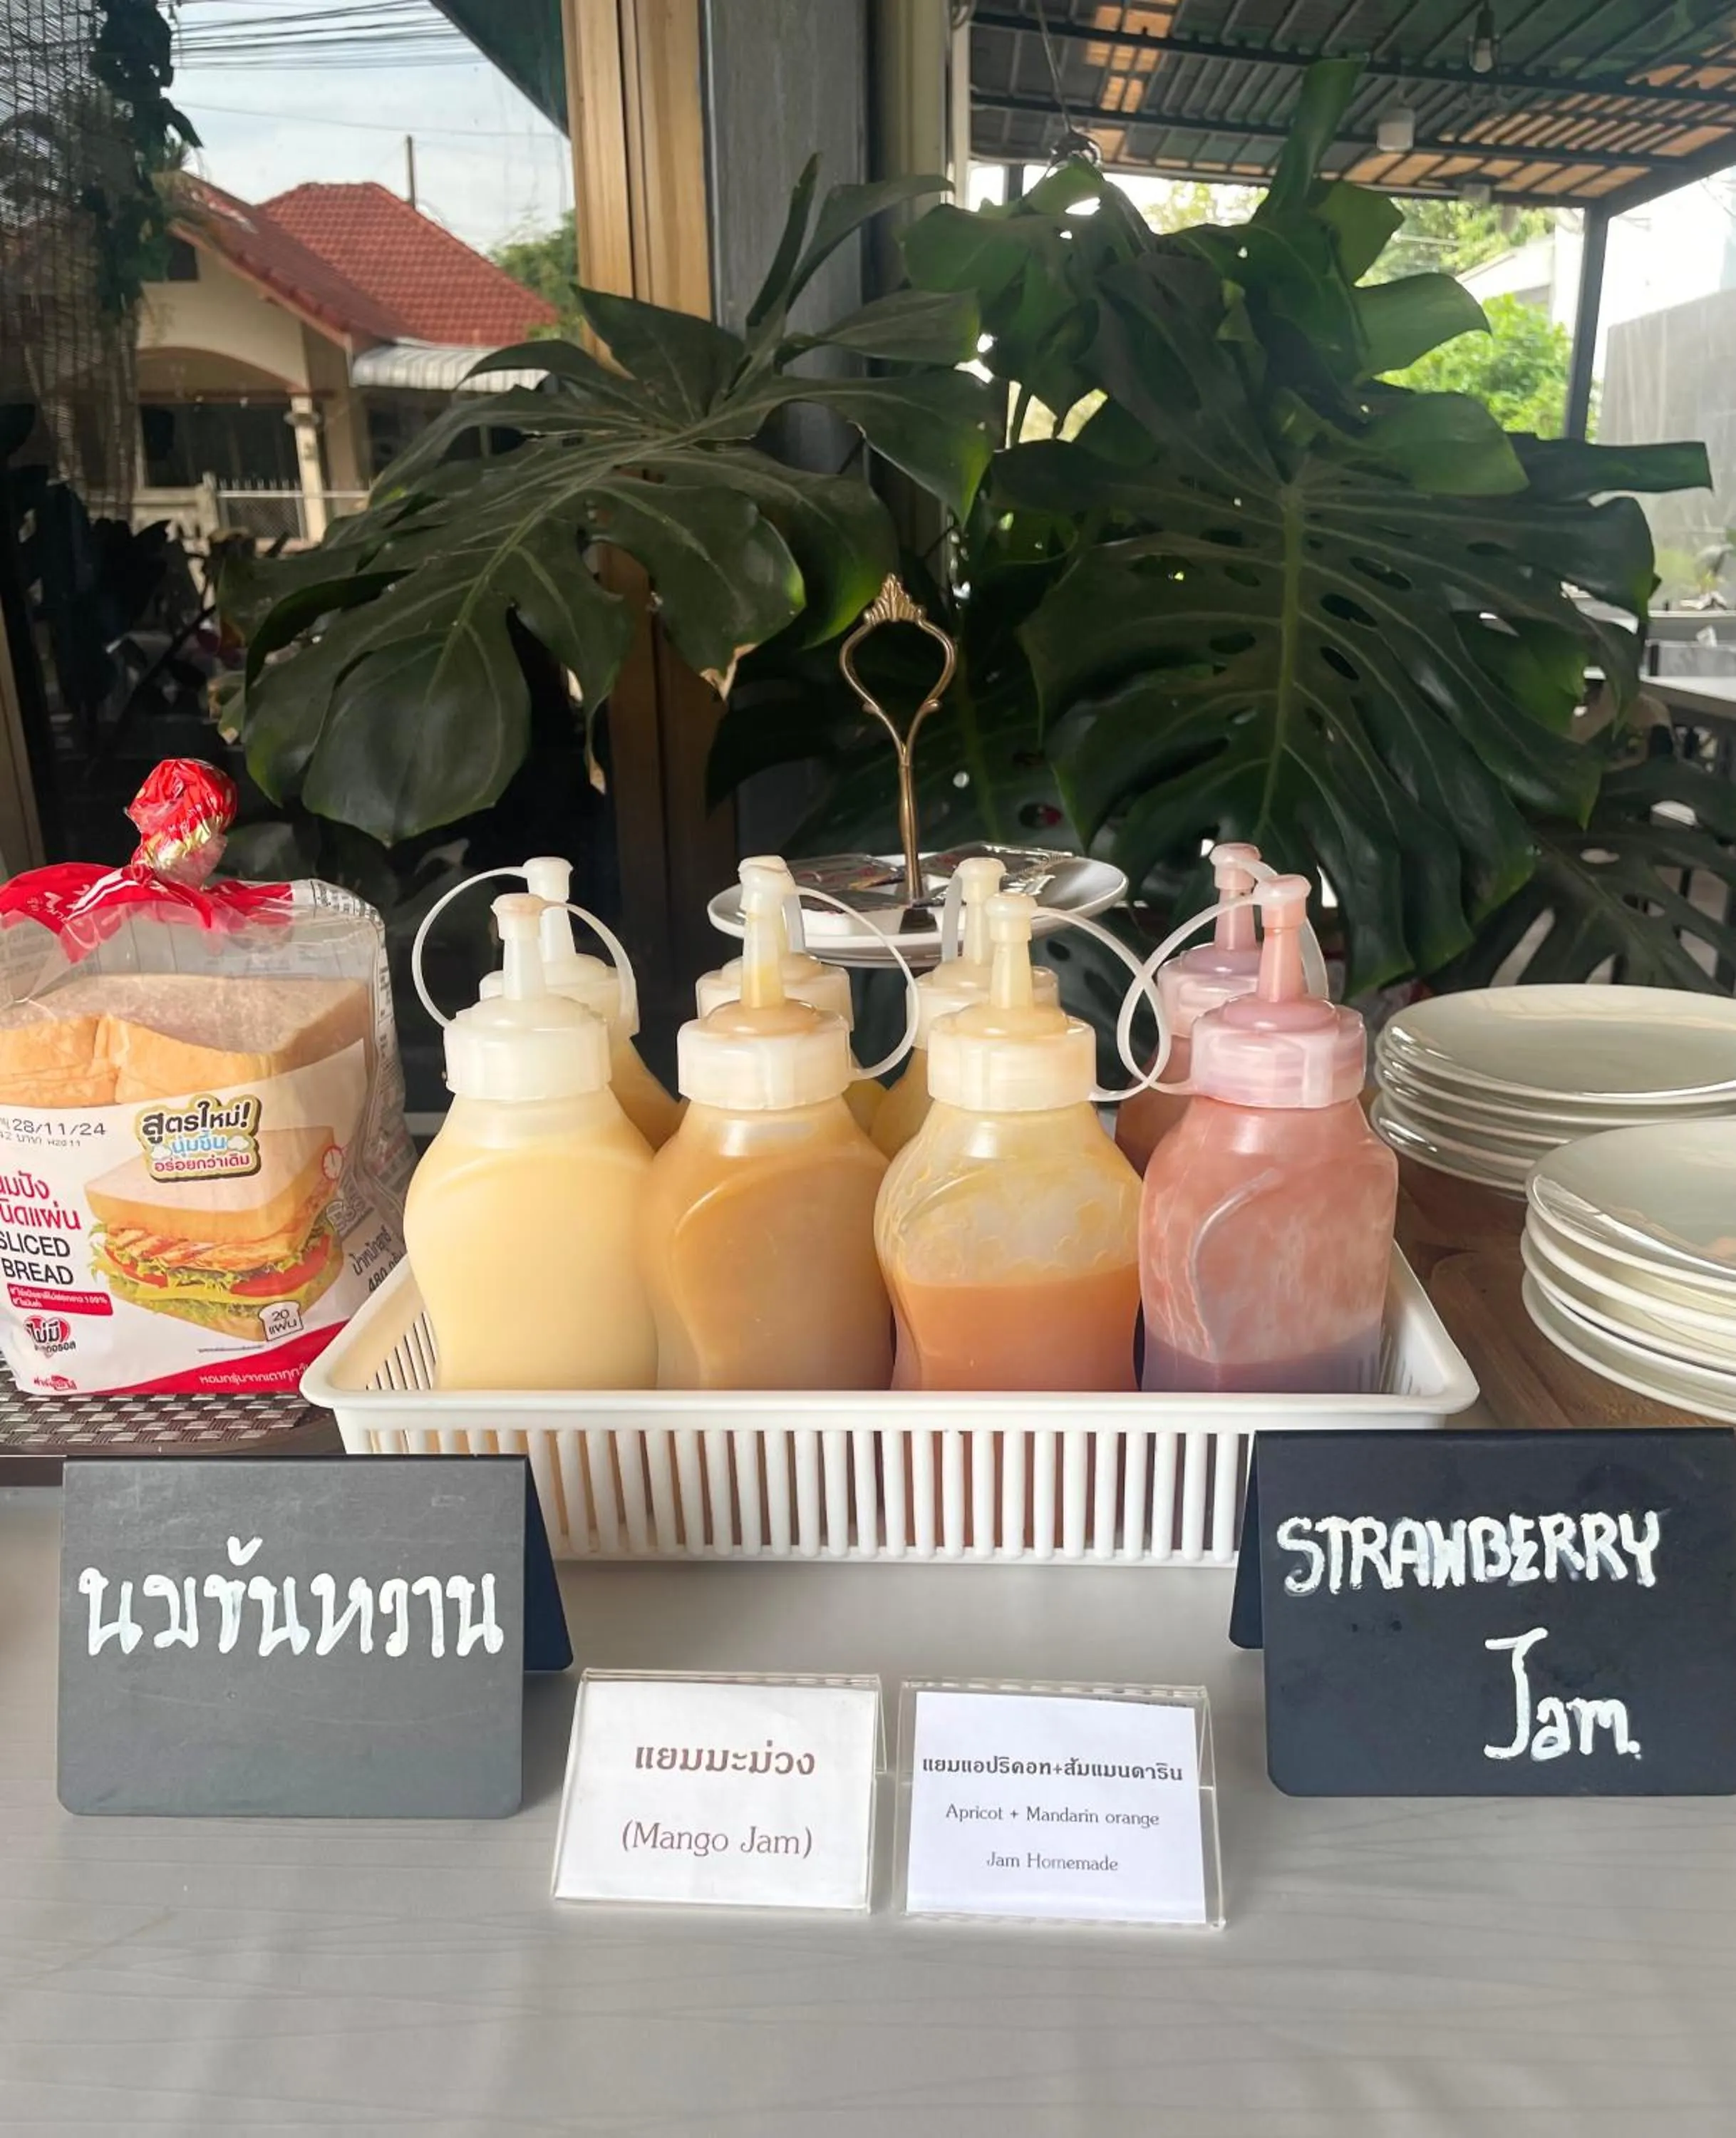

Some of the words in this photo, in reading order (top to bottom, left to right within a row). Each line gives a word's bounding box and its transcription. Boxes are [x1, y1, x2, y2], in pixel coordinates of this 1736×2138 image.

[12, 1118, 106, 1135] 28/11/24
[143, 1100, 251, 1144] สูตรใหม่!
[154, 1153, 249, 1172] อร่อยกว่าเดิม
[0, 1231, 71, 1257] SLICED
[1, 1257, 74, 1285] BREAD
[272, 1308, 290, 1321] 20
[1276, 1510, 1662, 1595] STRAWBERRY
[635, 1740, 815, 1775] แยมมะม่วง
[946, 1803, 1003, 1823] Apricot
[1010, 1809, 1019, 1819] +
[1026, 1805, 1099, 1823] Mandarin
[1105, 1812, 1160, 1828] orange
[622, 1820, 729, 1857] (Mango
[740, 1826, 812, 1859] Jam)
[986, 1851, 1021, 1868] Jam
[1027, 1852, 1119, 1871] Homemade
